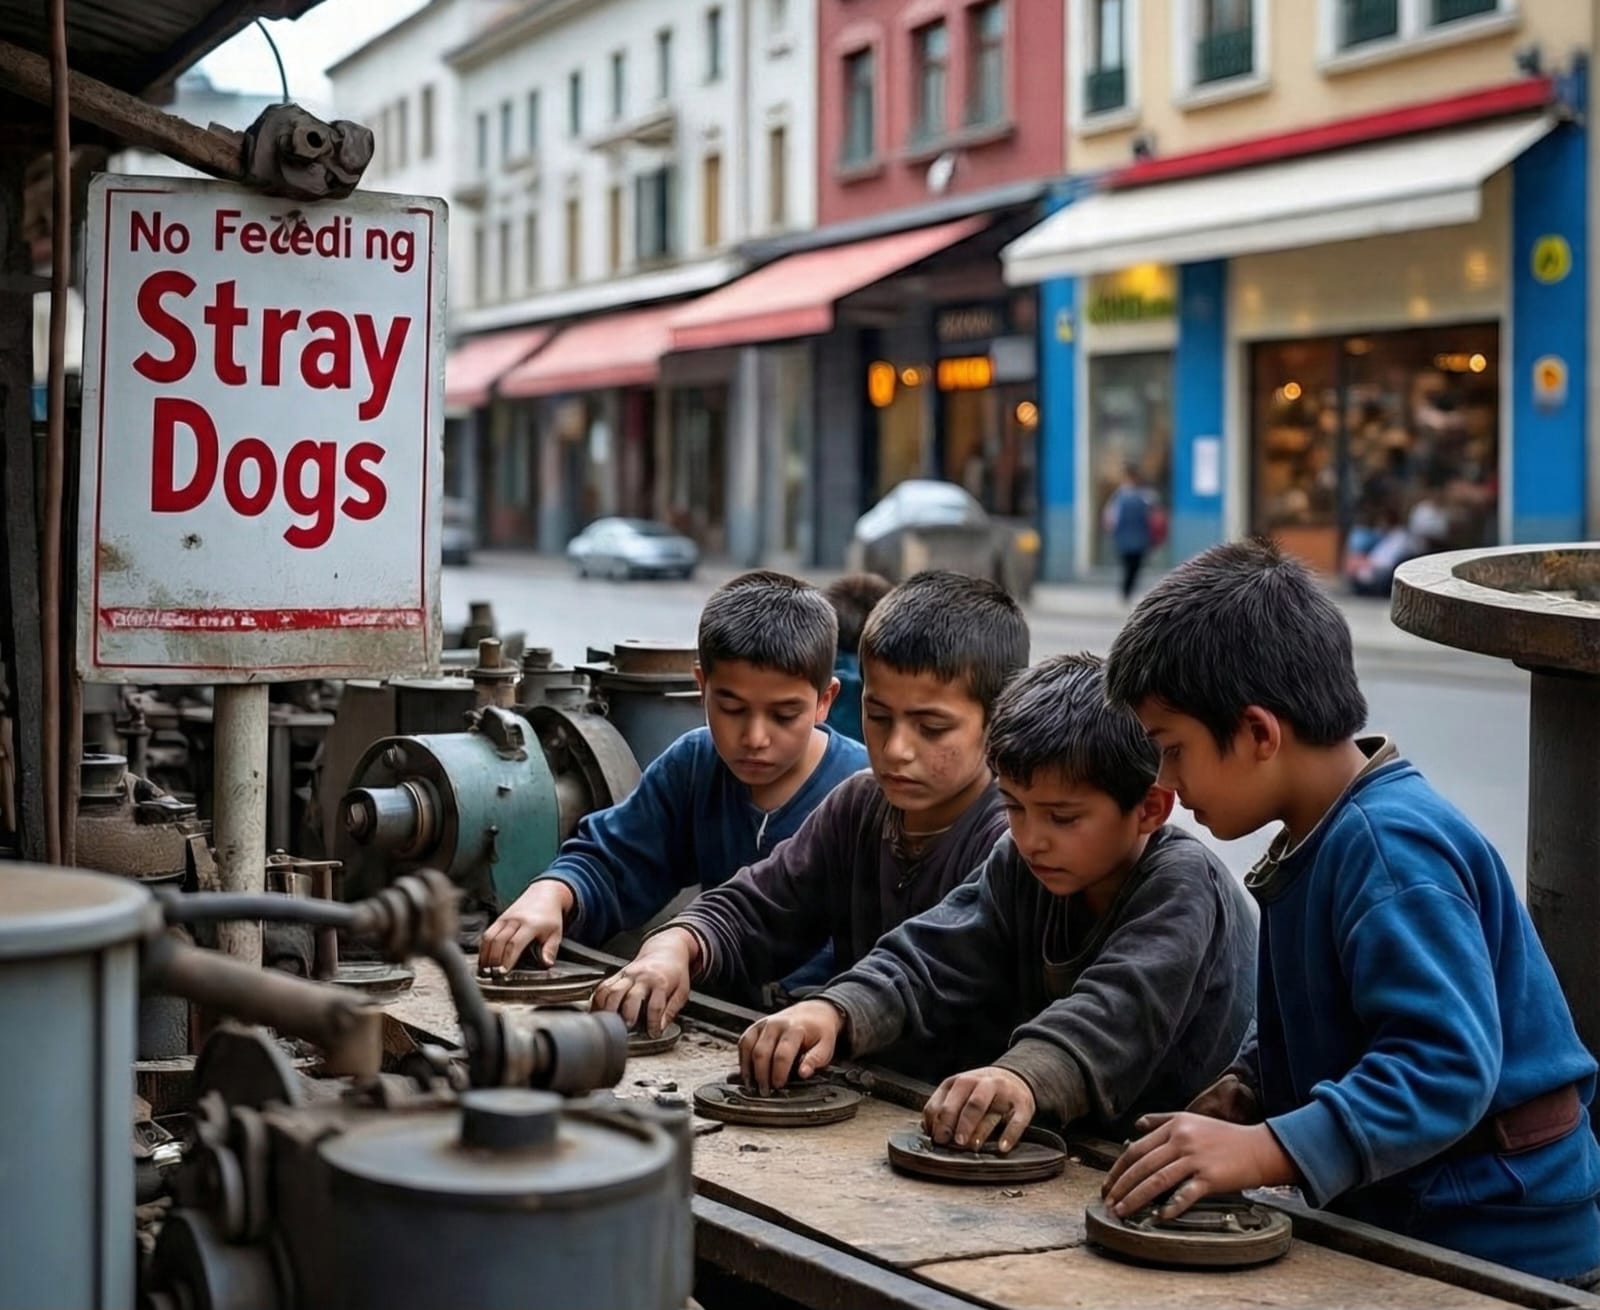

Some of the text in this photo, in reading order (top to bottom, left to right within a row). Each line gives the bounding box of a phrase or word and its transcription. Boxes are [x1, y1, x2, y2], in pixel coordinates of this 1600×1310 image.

[130, 210, 190, 254] No
[132, 270, 411, 421] Stray
[151, 397, 387, 549] Dogs
